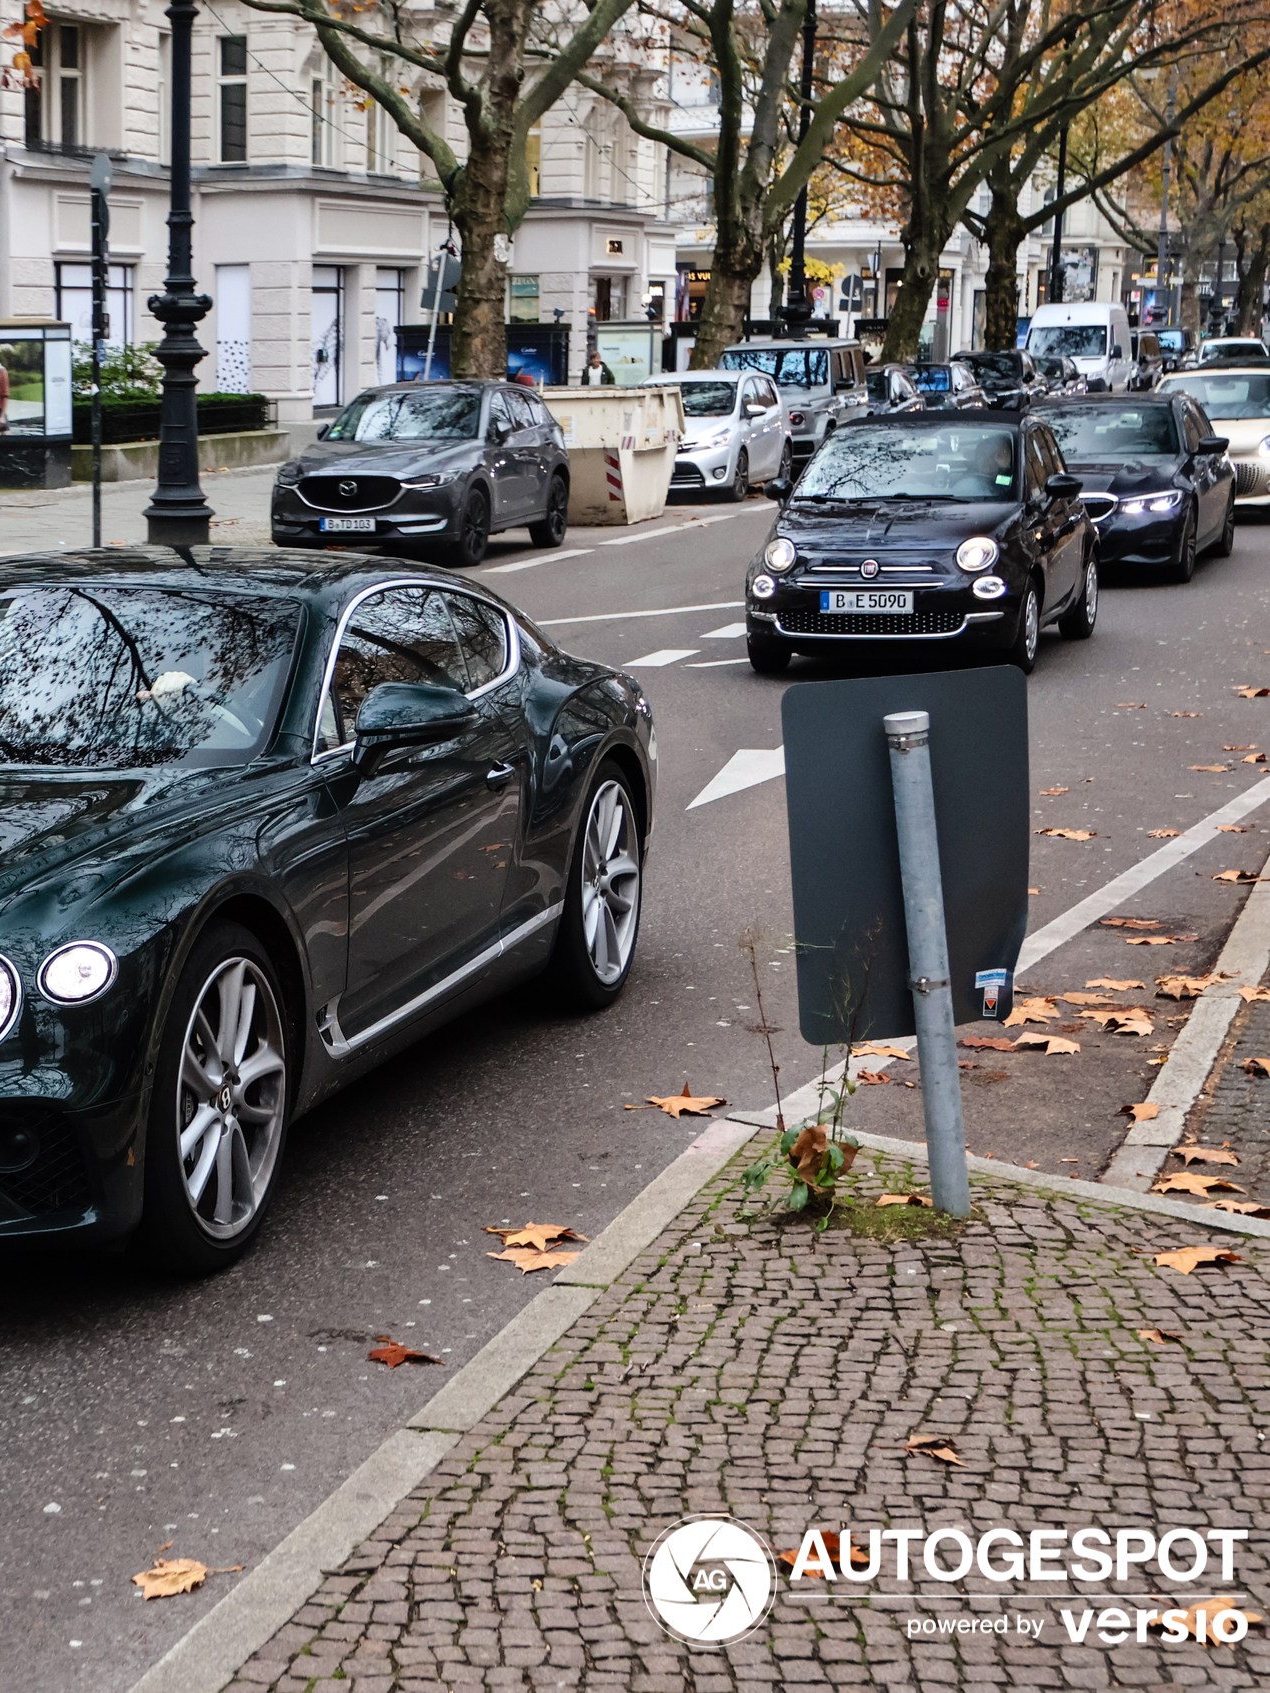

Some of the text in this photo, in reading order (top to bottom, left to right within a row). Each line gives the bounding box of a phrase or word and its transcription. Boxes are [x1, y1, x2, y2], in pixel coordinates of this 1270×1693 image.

[328, 519, 334, 529] B
[354, 519, 370, 529] 103
[836, 594, 906, 608] B E 5090
